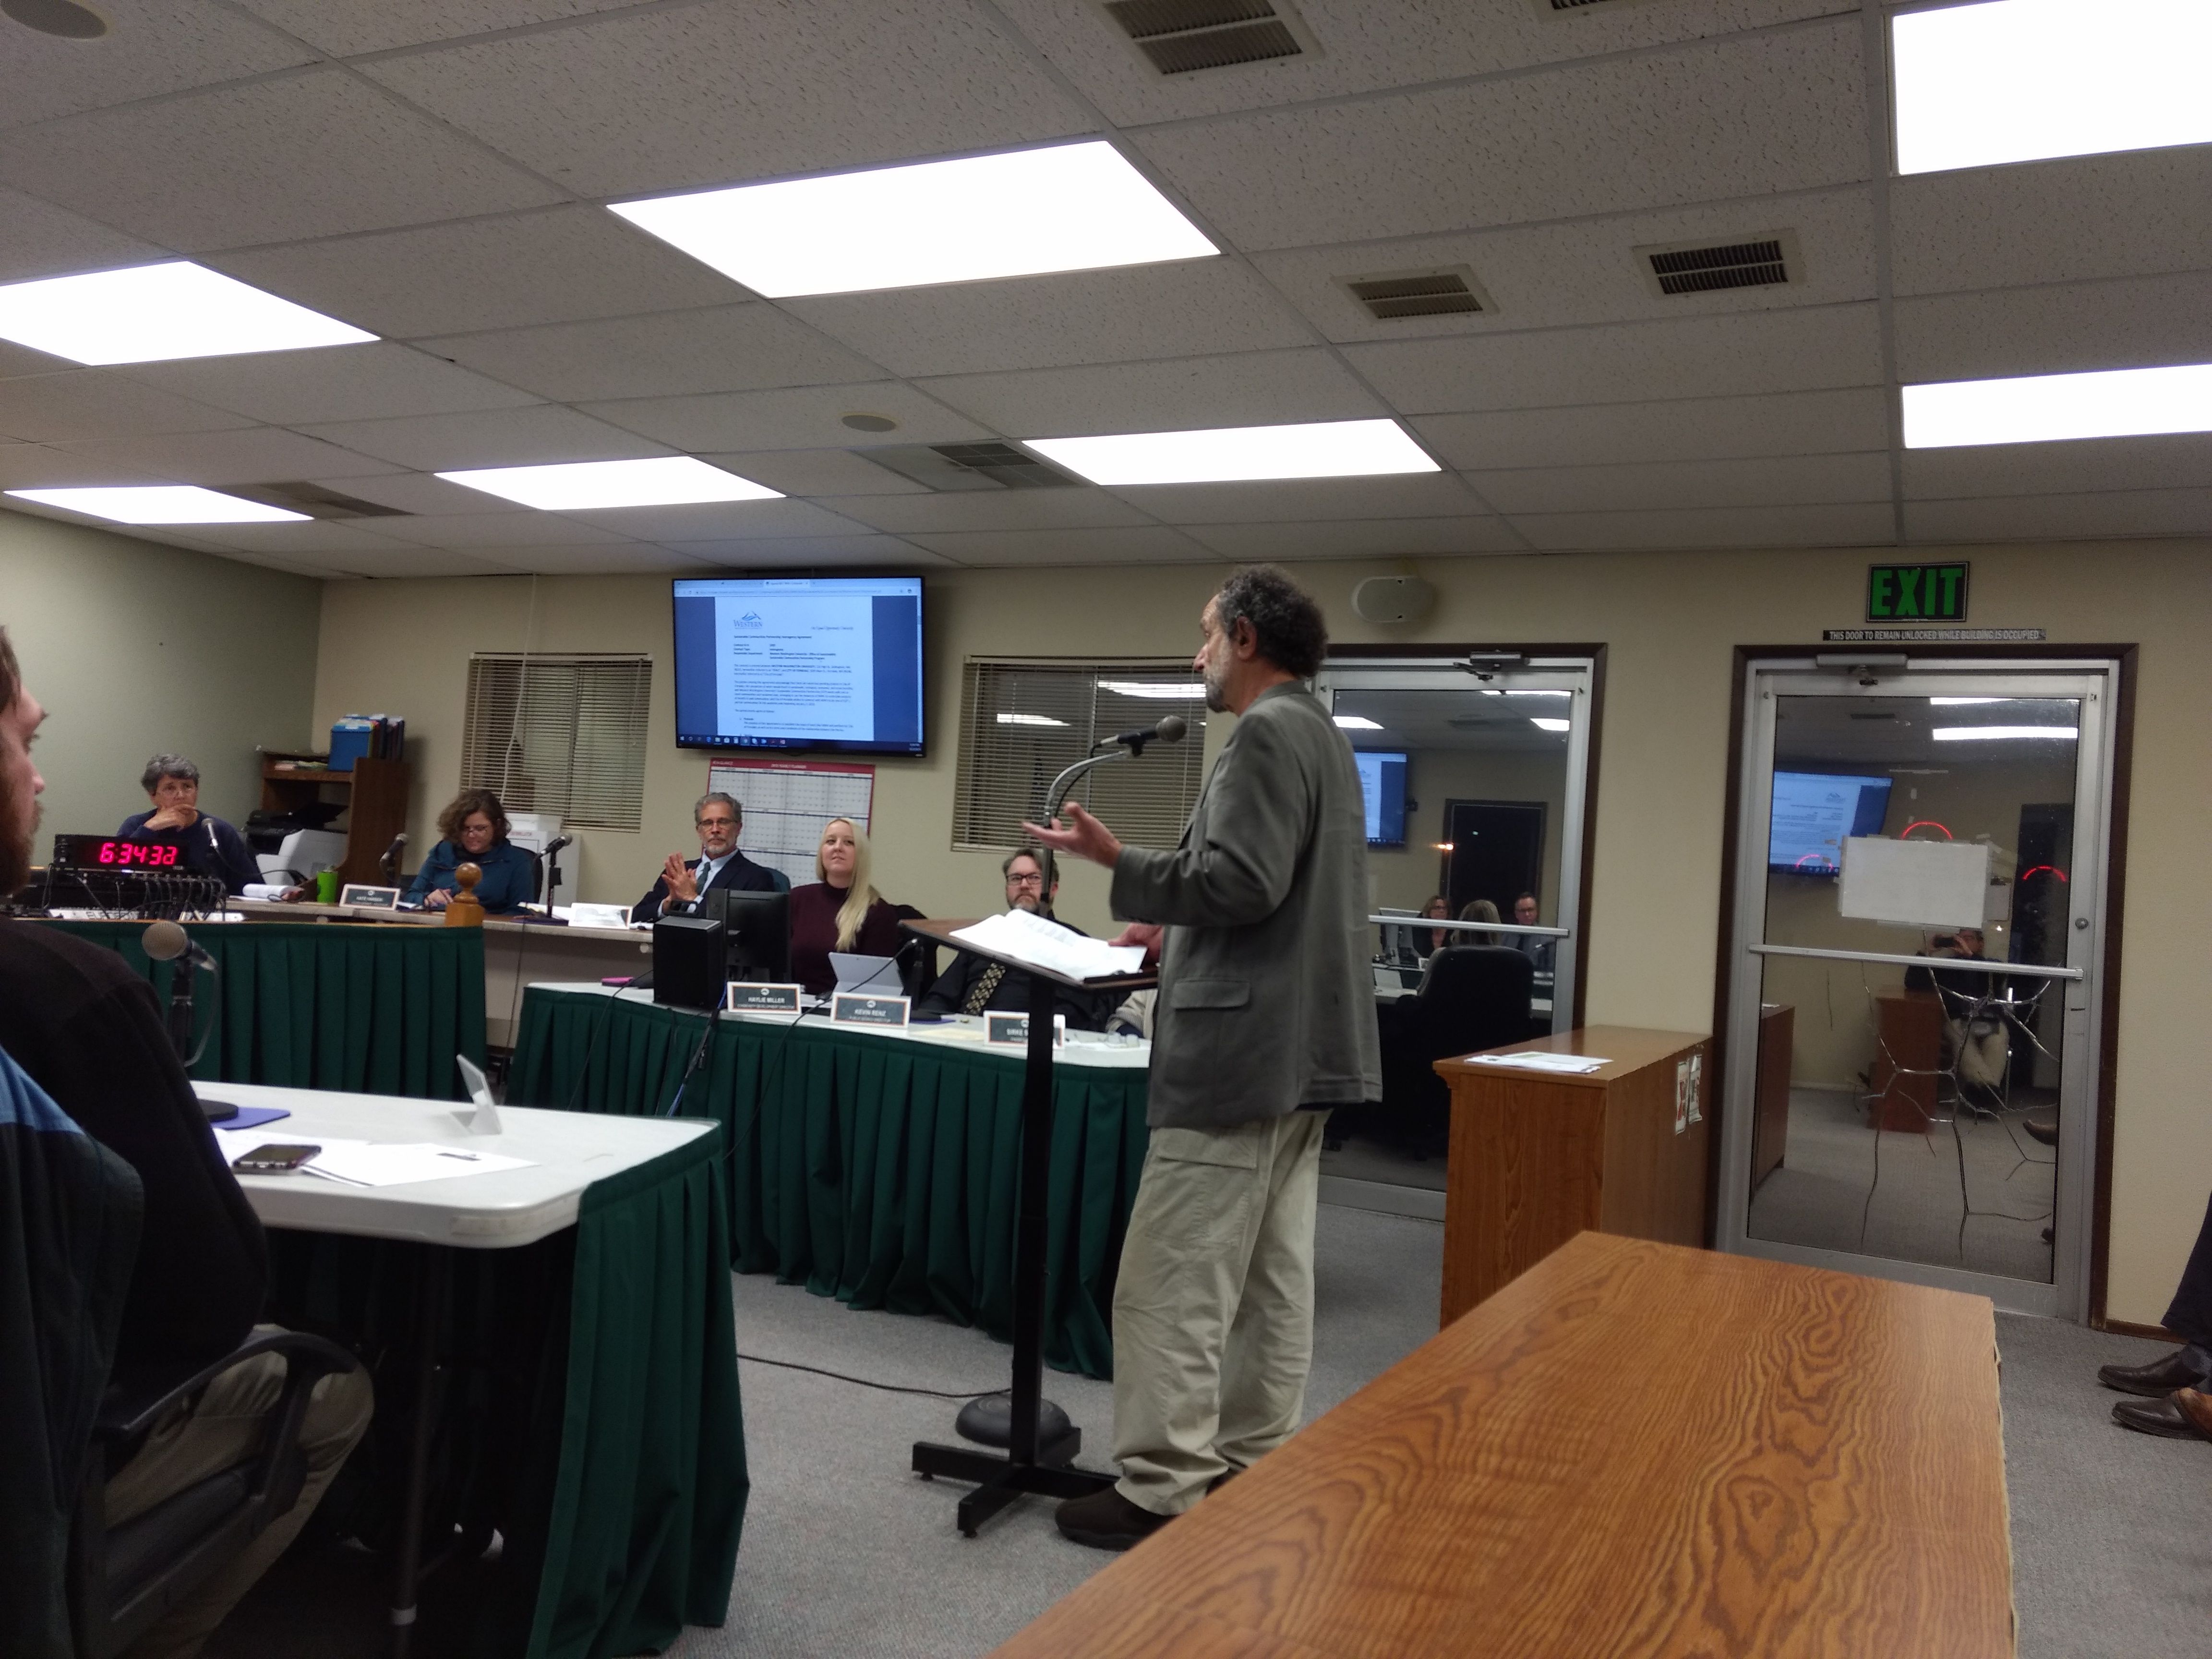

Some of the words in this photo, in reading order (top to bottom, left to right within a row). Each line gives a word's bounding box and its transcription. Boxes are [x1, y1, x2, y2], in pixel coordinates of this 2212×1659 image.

[1872, 568, 1962, 616] EXIT
[1829, 631, 1844, 639] THIS
[1845, 631, 1863, 640] DOOR
[1865, 631, 1873, 639] TO
[1875, 631, 1899, 639] REMAIN
[1901, 631, 1936, 639] UNLOCKED
[1938, 630, 1960, 639] WHILE
[1961, 630, 1993, 639] BUILDING
[1995, 630, 2002, 639] IS
[2004, 630, 2039, 639] OCCUPIED
